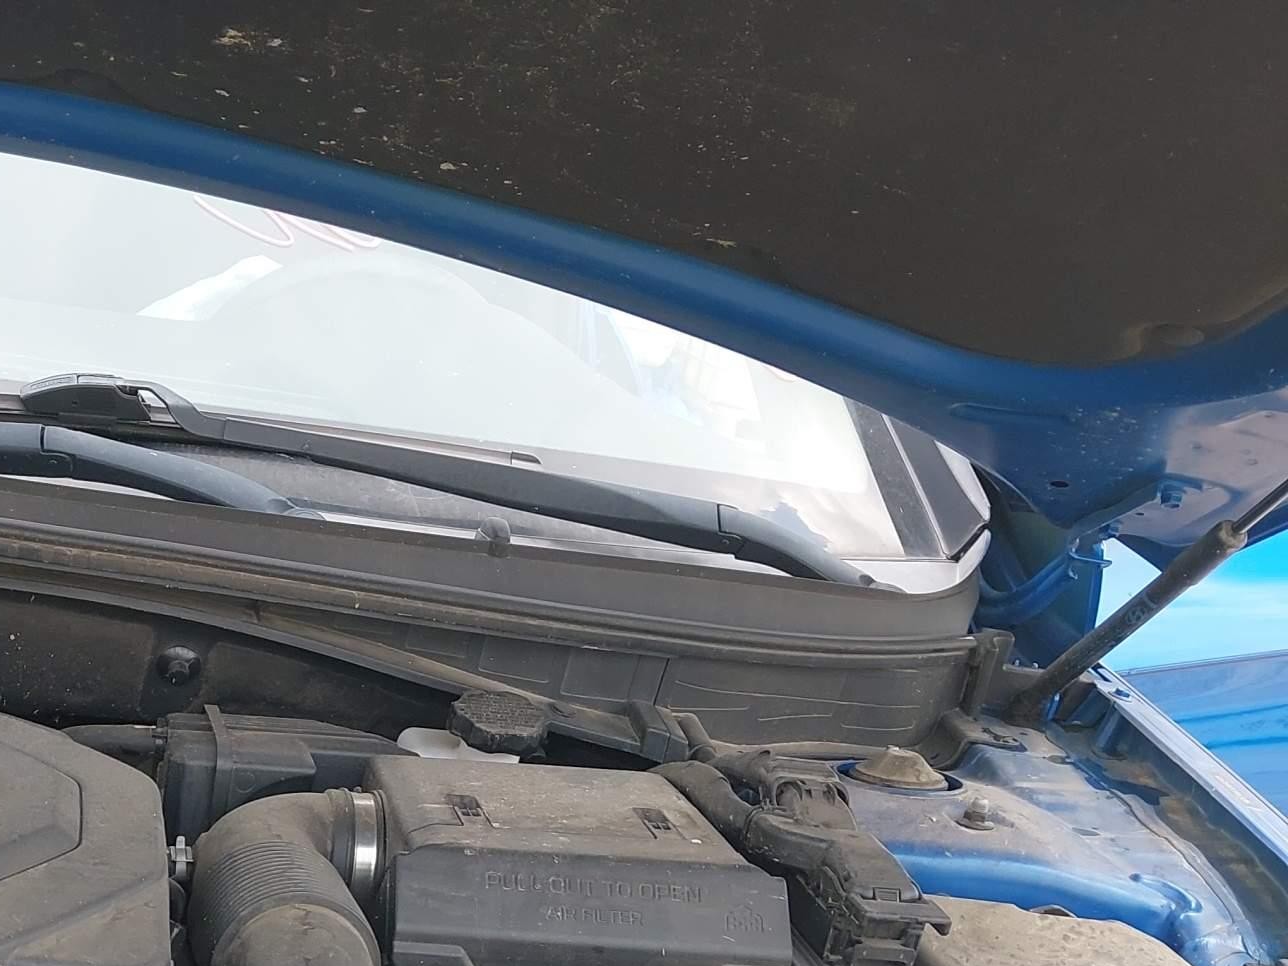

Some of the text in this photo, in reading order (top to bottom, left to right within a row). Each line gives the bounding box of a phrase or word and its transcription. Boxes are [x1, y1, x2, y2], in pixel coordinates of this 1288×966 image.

[484, 870, 703, 903] PULL OUT TO OPEN
[545, 905, 644, 927] AIR FILTER
